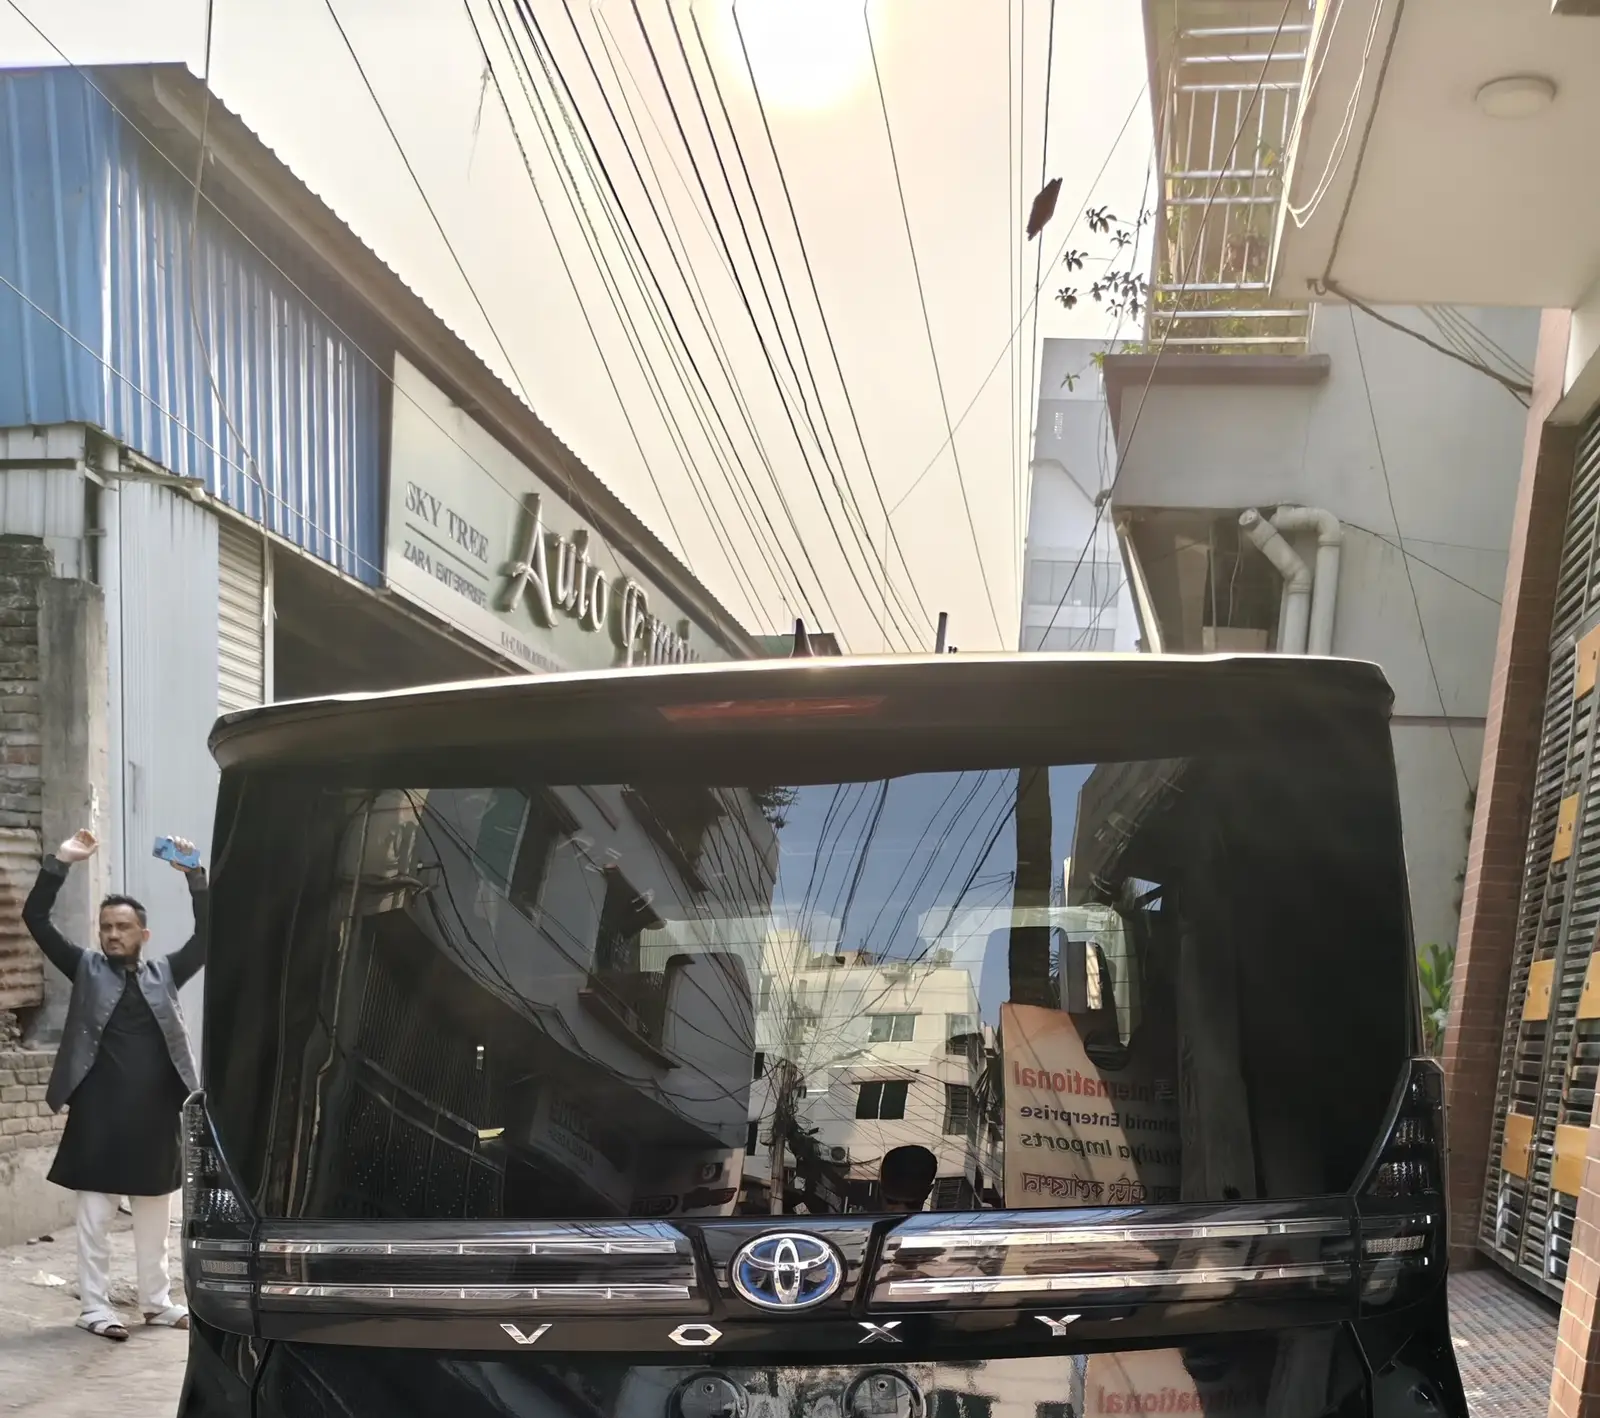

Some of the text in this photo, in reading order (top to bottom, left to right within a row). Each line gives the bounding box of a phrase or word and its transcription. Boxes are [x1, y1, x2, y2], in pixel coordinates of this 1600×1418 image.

[405, 481, 489, 563] SKY TREE
[404, 540, 432, 574] ZARA
[506, 491, 608, 633] Auto
[500, 1314, 1082, 1346] VOXY
